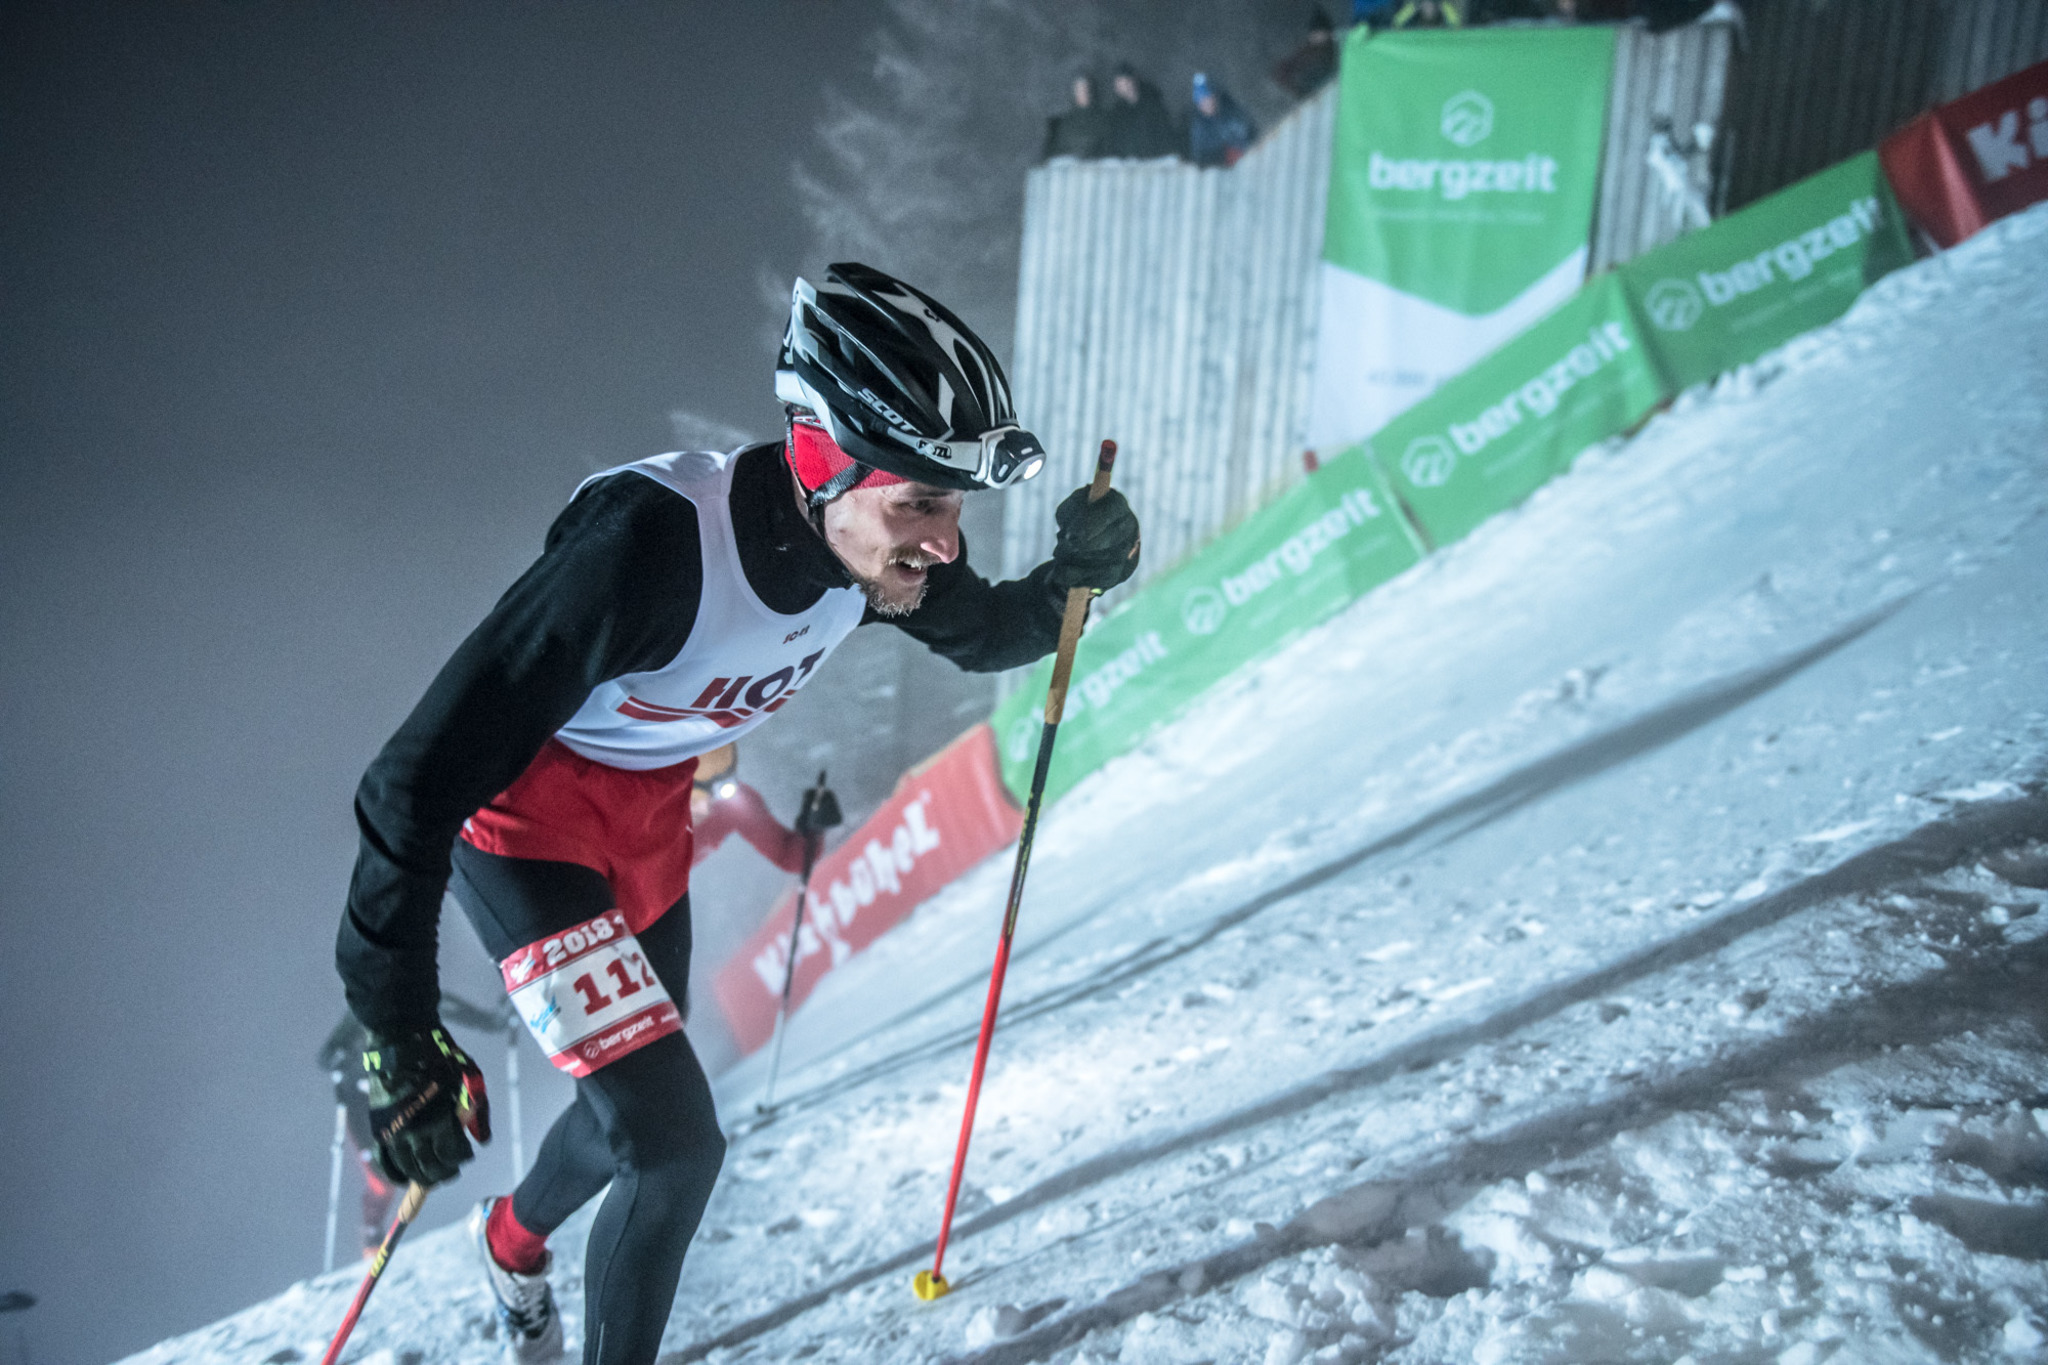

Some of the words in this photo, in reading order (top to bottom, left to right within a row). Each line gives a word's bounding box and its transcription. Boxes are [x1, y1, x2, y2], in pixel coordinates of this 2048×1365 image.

[1368, 151, 1557, 200] bergzeit
[1450, 320, 1631, 456] bergzeit
[1221, 487, 1382, 607] bergzeit
[542, 917, 616, 967] 2018
[599, 1015, 655, 1050] bergzeit
